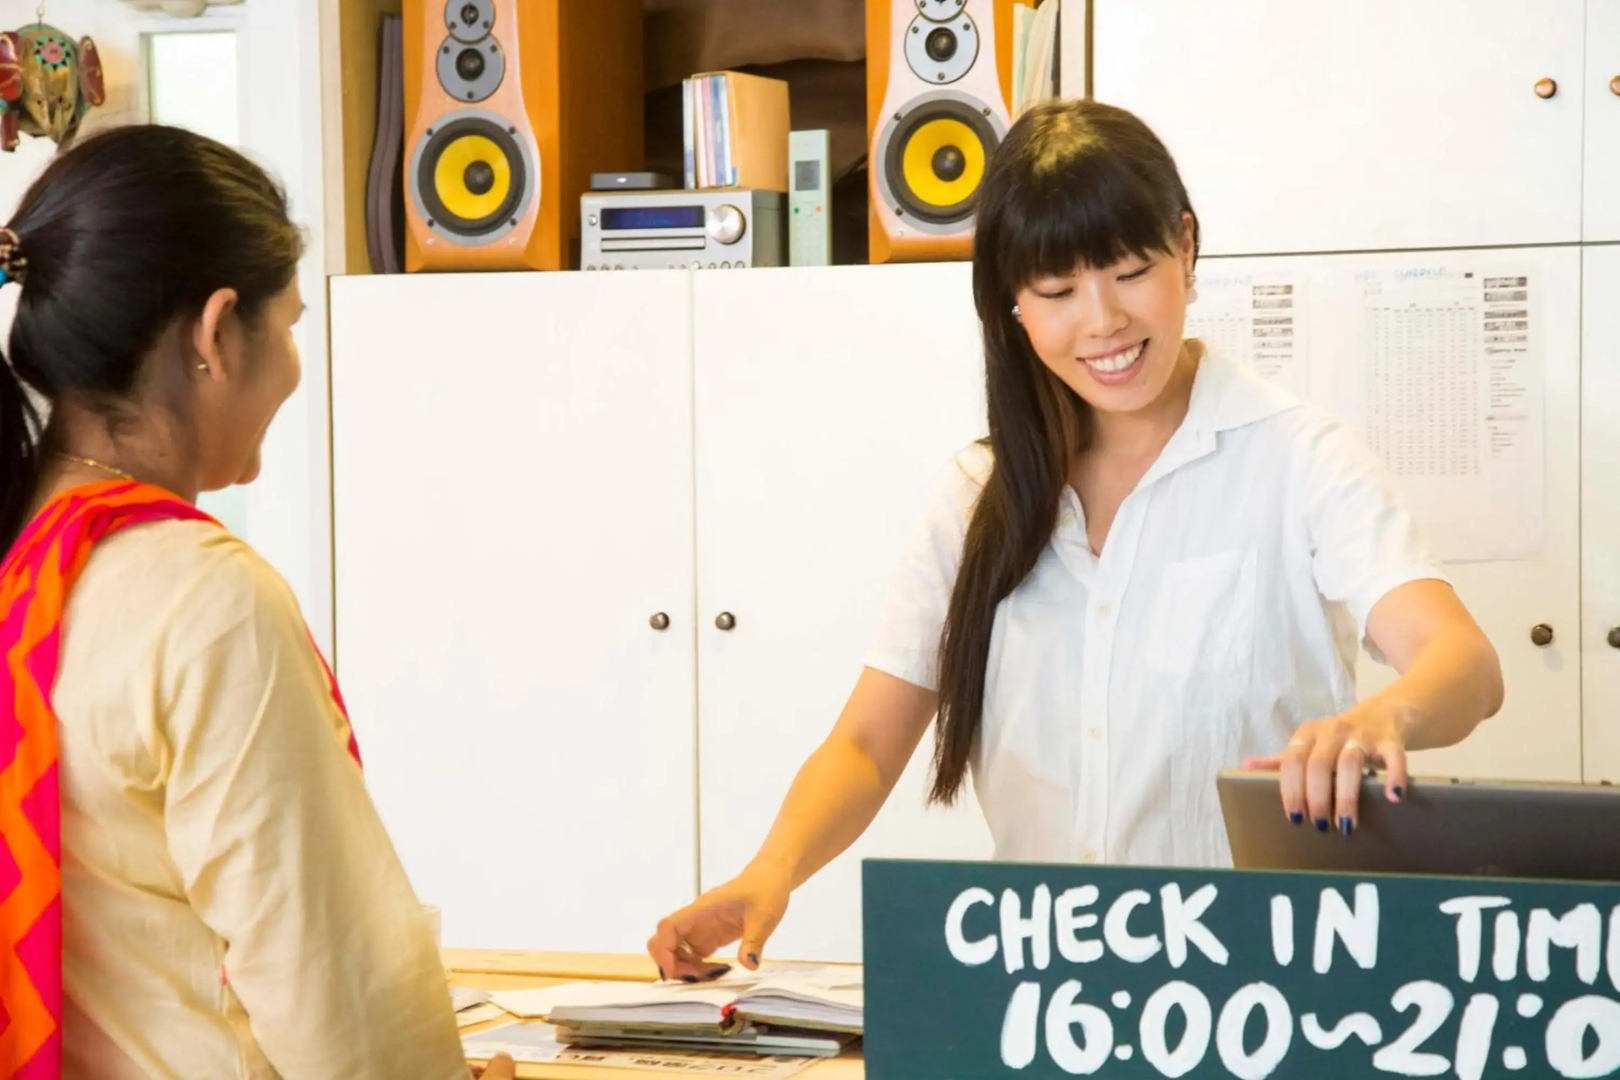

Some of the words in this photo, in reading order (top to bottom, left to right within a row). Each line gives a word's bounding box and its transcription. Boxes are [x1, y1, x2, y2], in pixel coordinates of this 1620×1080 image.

[944, 882, 1229, 974] CHECK
[1270, 883, 1380, 974] IN
[1439, 896, 1620, 992] TIM
